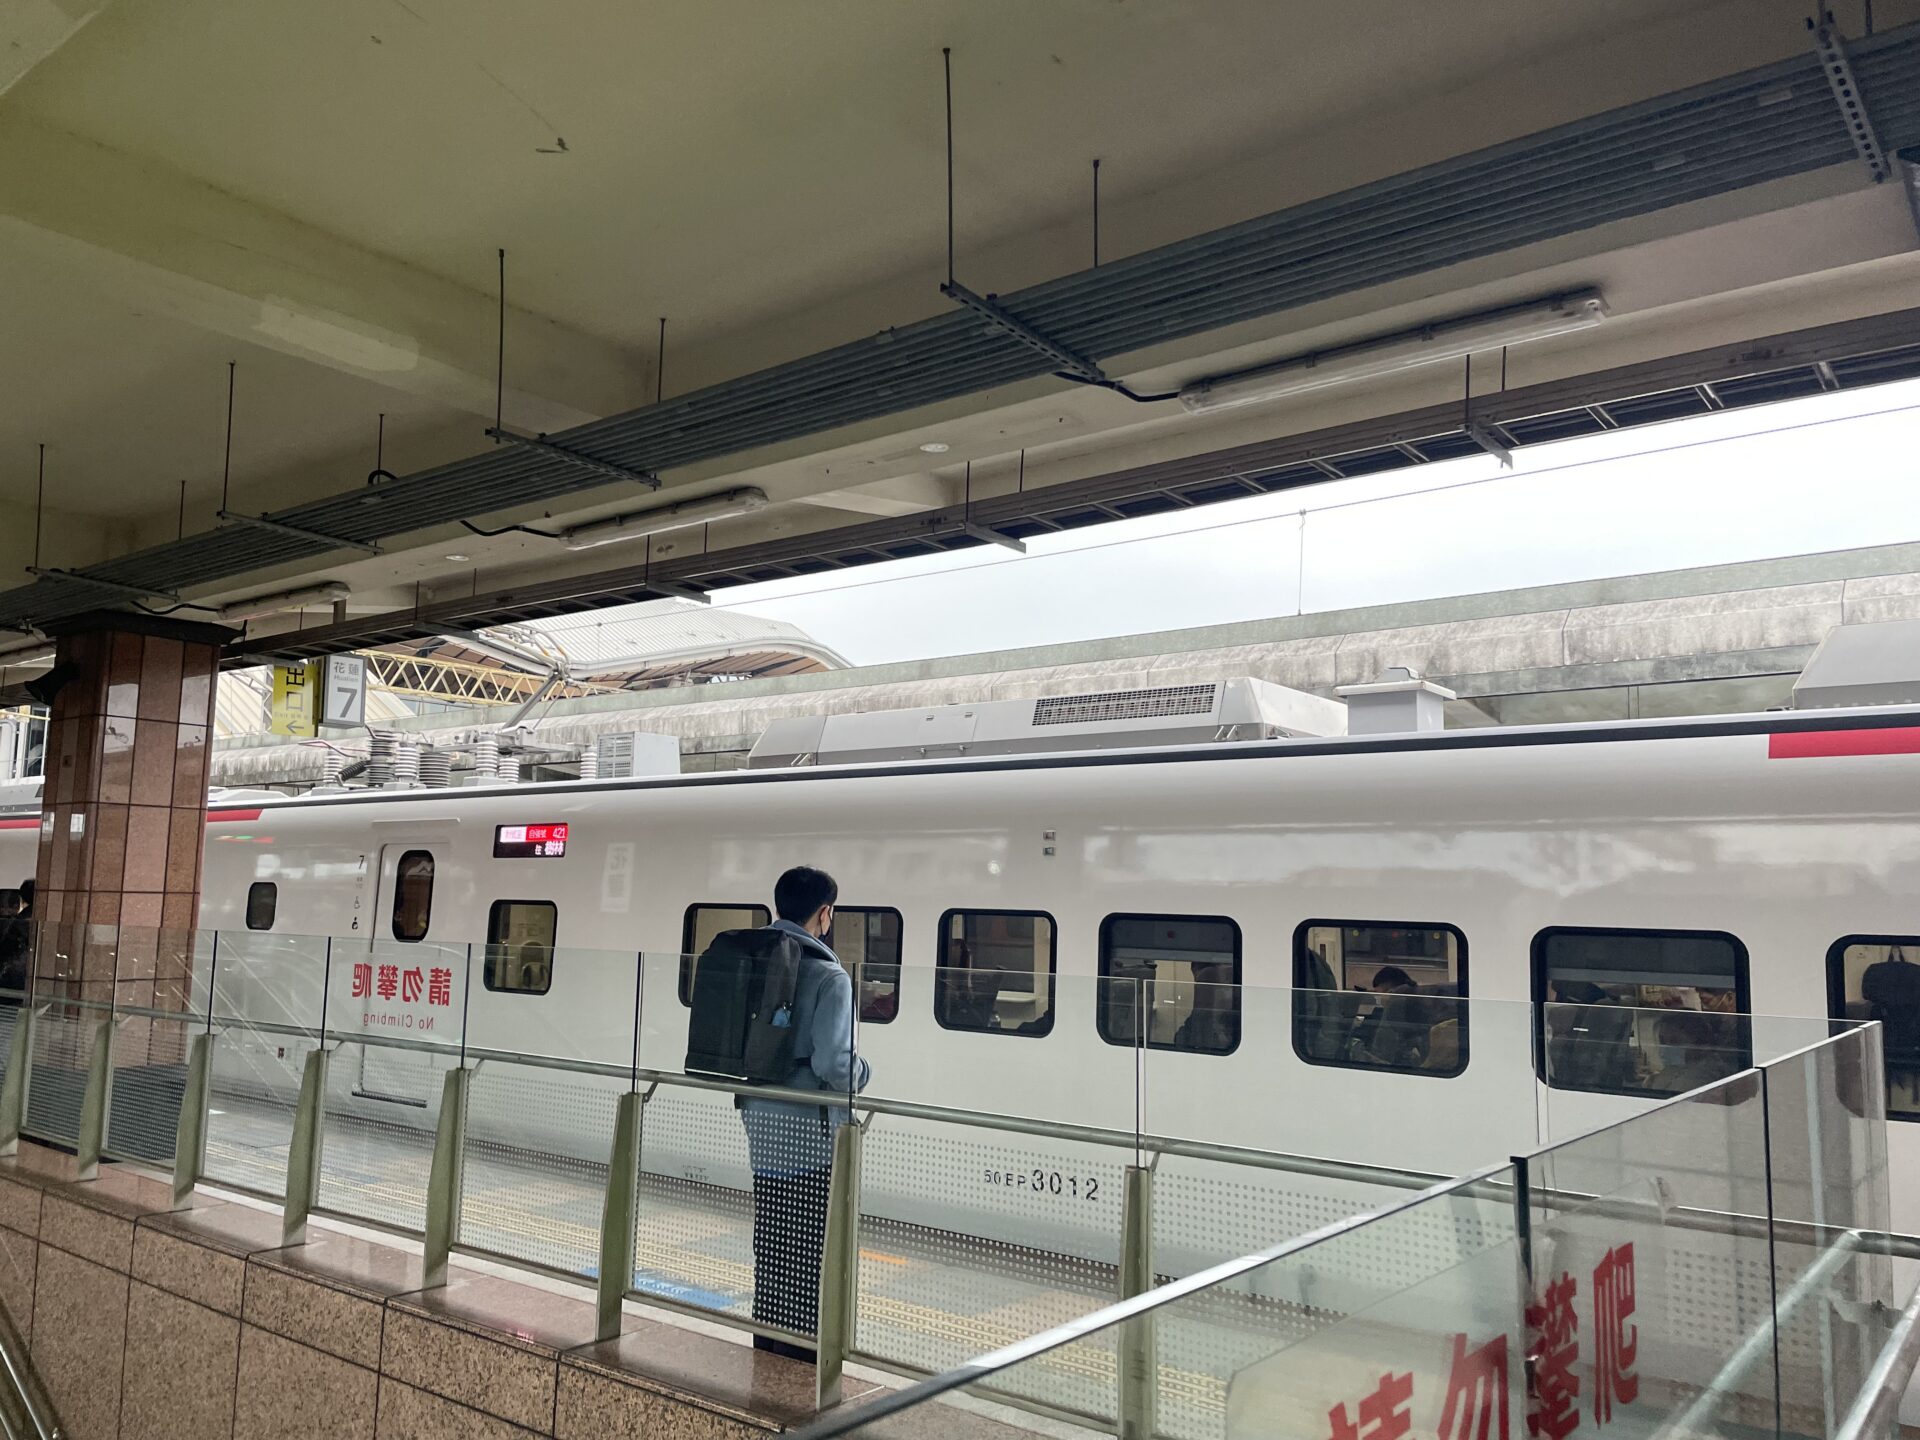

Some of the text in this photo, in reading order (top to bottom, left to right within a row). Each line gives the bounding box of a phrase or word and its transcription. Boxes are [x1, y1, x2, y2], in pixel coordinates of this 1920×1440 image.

[333, 662, 359, 676] 花蓮
[286, 667, 305, 713] 出口
[337, 687, 358, 718] 7
[552, 827, 566, 839] 421
[359, 855, 365, 869] 7
